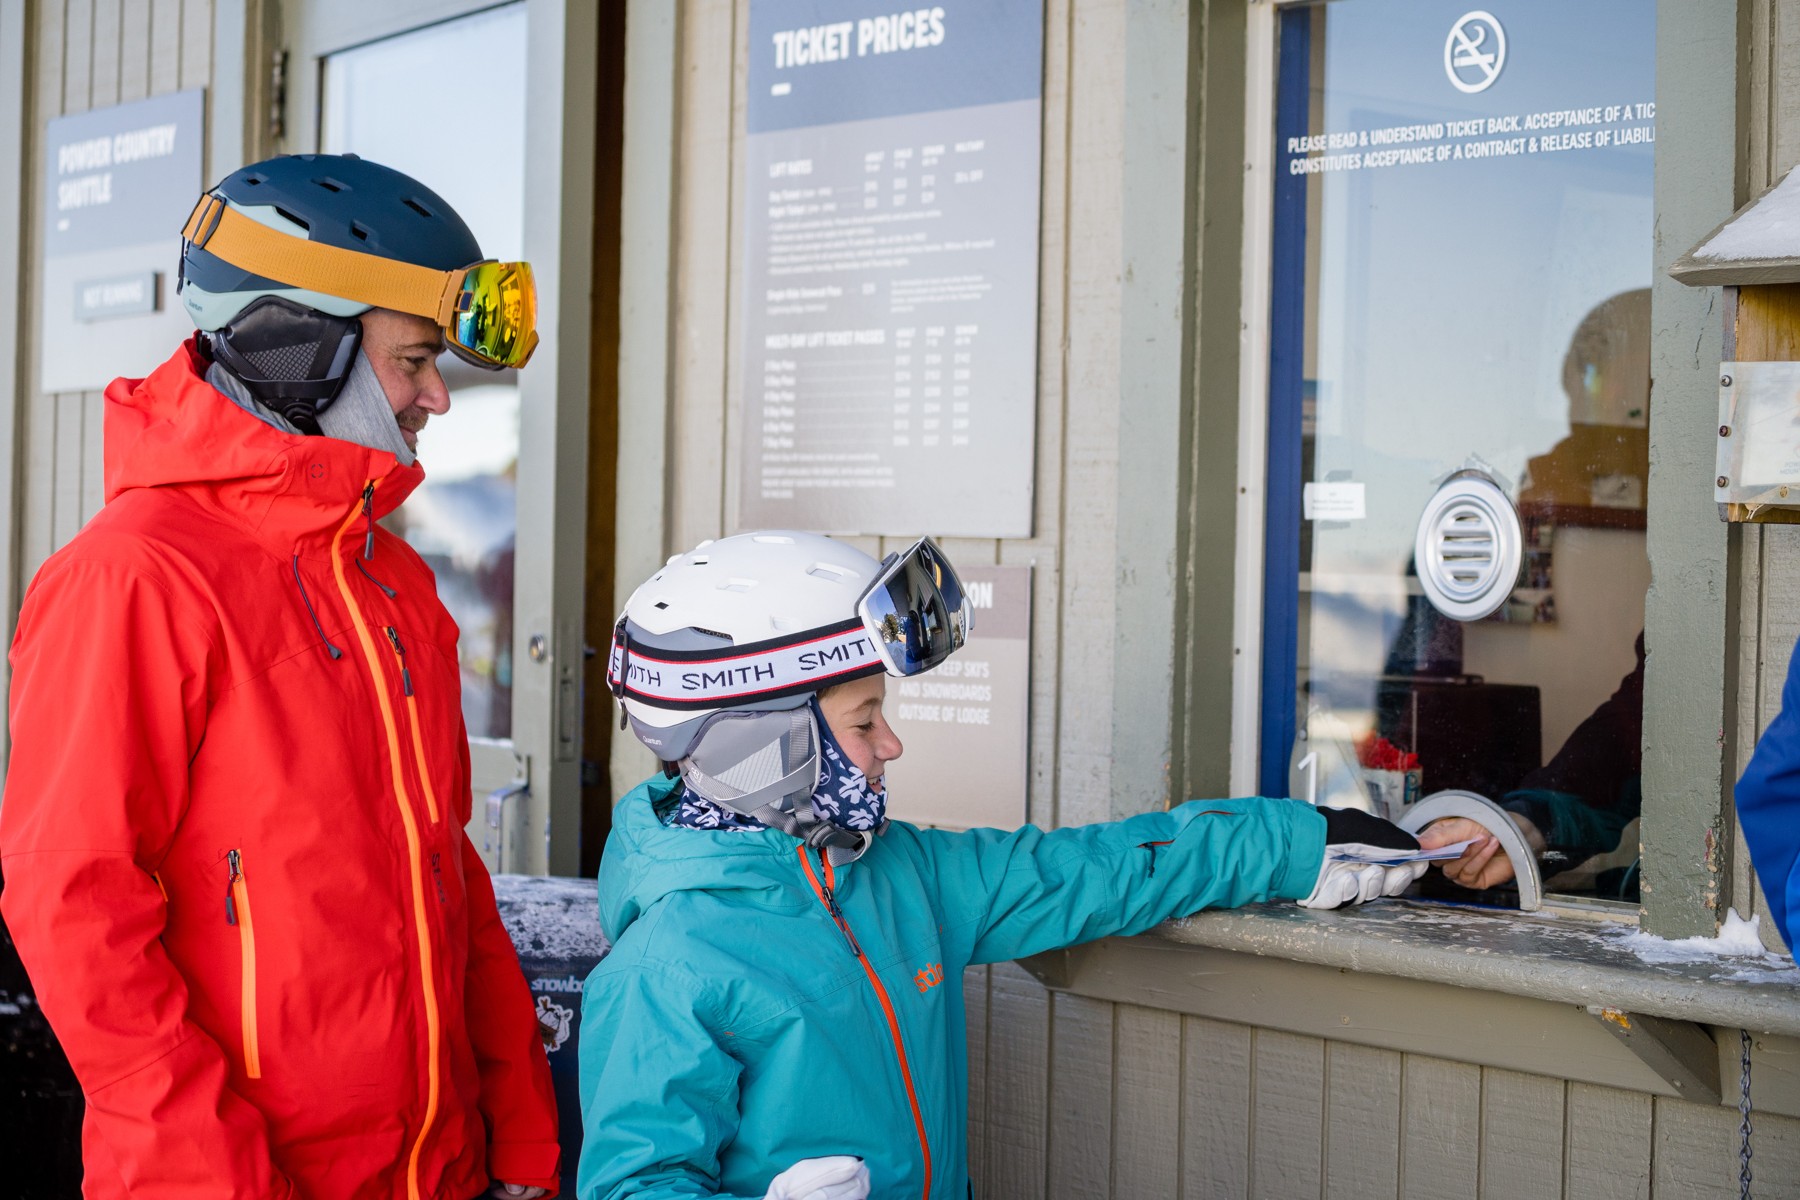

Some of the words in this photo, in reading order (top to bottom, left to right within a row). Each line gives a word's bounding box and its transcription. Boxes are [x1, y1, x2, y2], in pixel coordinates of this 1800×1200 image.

[772, 21, 853, 69] TICKET
[857, 6, 945, 57] PRICES
[113, 123, 177, 164] COUNTRY
[1287, 134, 1326, 154] PLEASE
[1328, 131, 1357, 149] READ
[1359, 131, 1368, 147] &
[1370, 123, 1443, 145] UNDERSTAND
[1446, 118, 1485, 138] TICKET
[1487, 116, 1521, 134] BACK.
[1524, 107, 1602, 130] ACCEPTANCE
[1604, 106, 1620, 122] OF
[1623, 105, 1632, 121] A
[1290, 153, 1361, 175] CONSTITUTES
[1363, 146, 1434, 168] ACCEPTANCE
[1436, 144, 1452, 161] OF
[1453, 144, 1462, 160] A
[1465, 137, 1526, 159] CONTRACT
[1528, 138, 1538, 153] &
[1540, 134, 1592, 152] RELEASE
[1595, 130, 1611, 147] OF
[681, 662, 775, 691] SMITH
[798, 636, 877, 671] SMIT
[898, 681, 920, 698] AND
[922, 682, 992, 702] SNOWBOARDS
[898, 703, 941, 722] OUTSIDE
[942, 706, 955, 722] OF
[957, 707, 990, 725] LODGE
